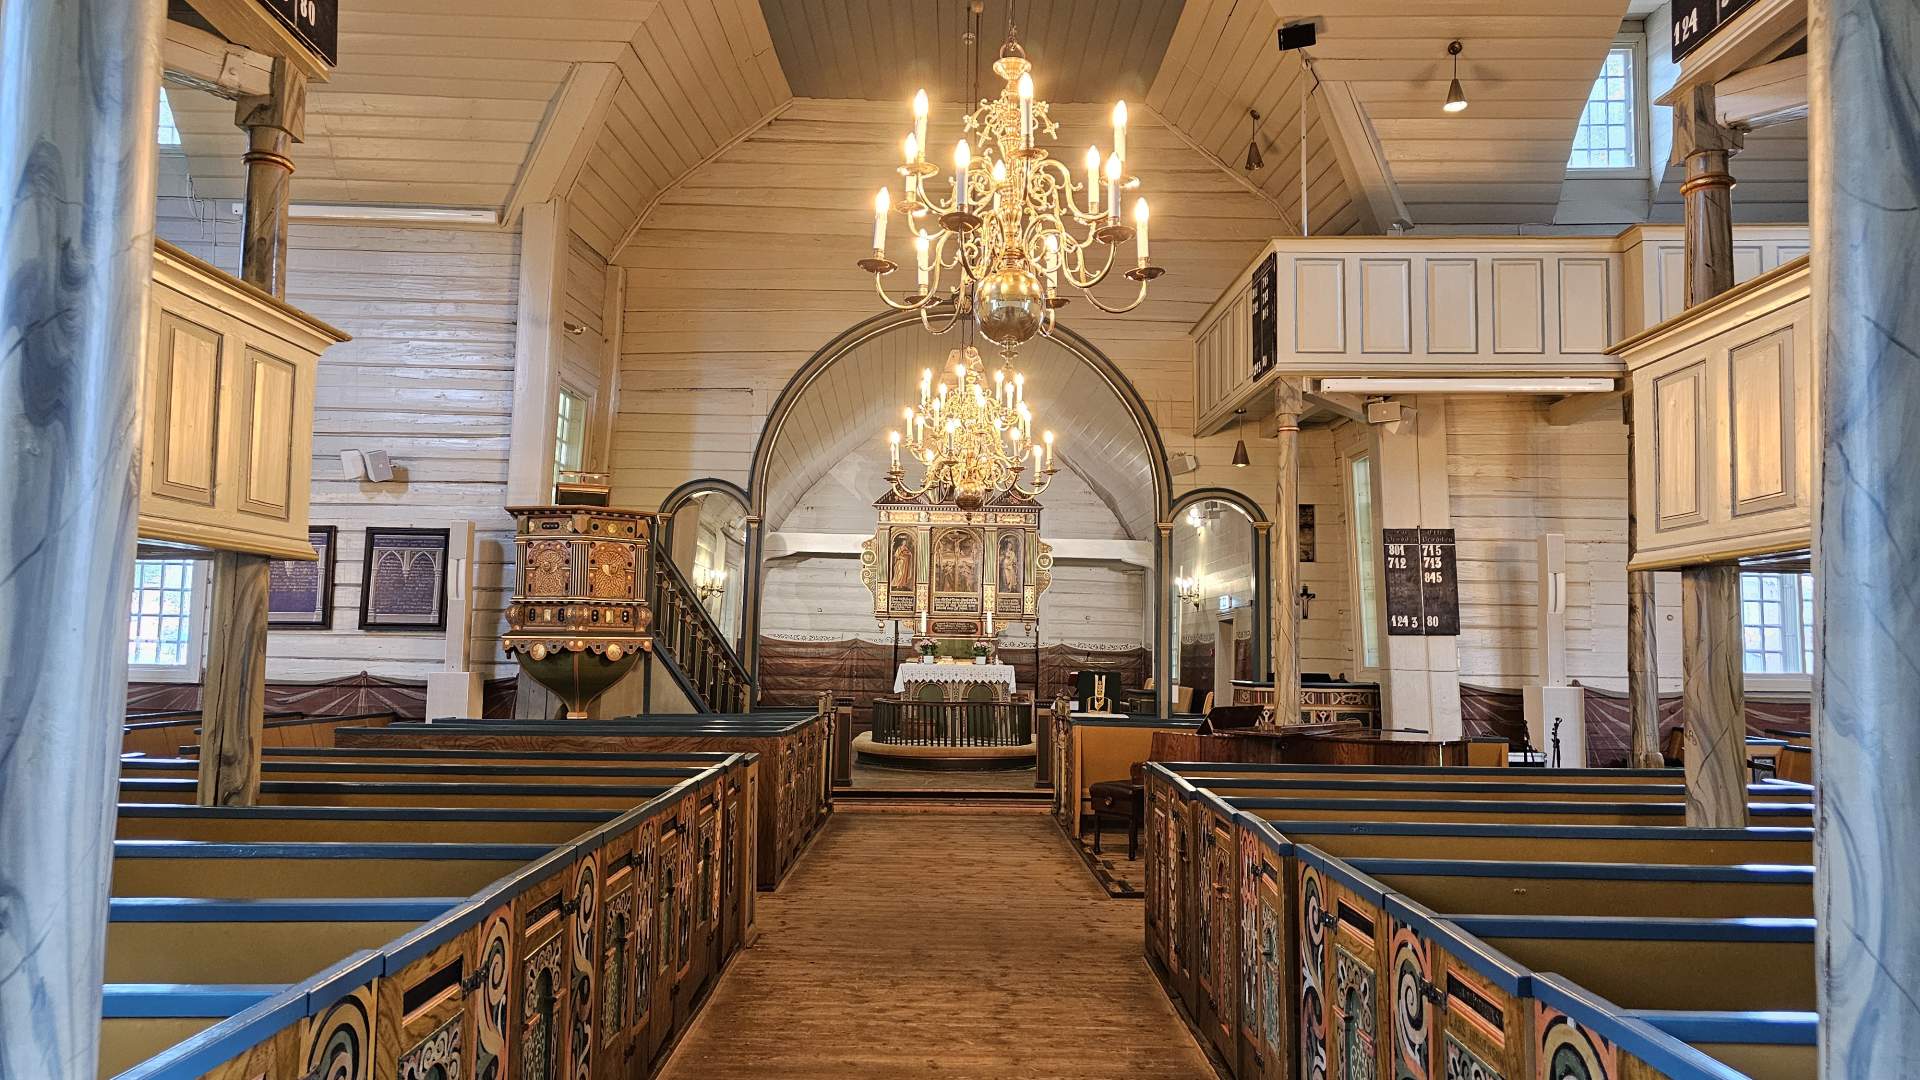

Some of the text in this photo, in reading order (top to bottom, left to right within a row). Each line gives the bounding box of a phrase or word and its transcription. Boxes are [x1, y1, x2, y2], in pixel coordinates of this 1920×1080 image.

[1674, 7, 1698, 47] 124
[1389, 545, 1405, 556] 801
[1422, 545, 1442, 556] 715
[1388, 557, 1407, 569] 712
[1424, 557, 1442, 569] 713
[1425, 572, 1442, 583] 845
[1391, 615, 1418, 628] 124 3
[1427, 615, 1438, 627] 80
